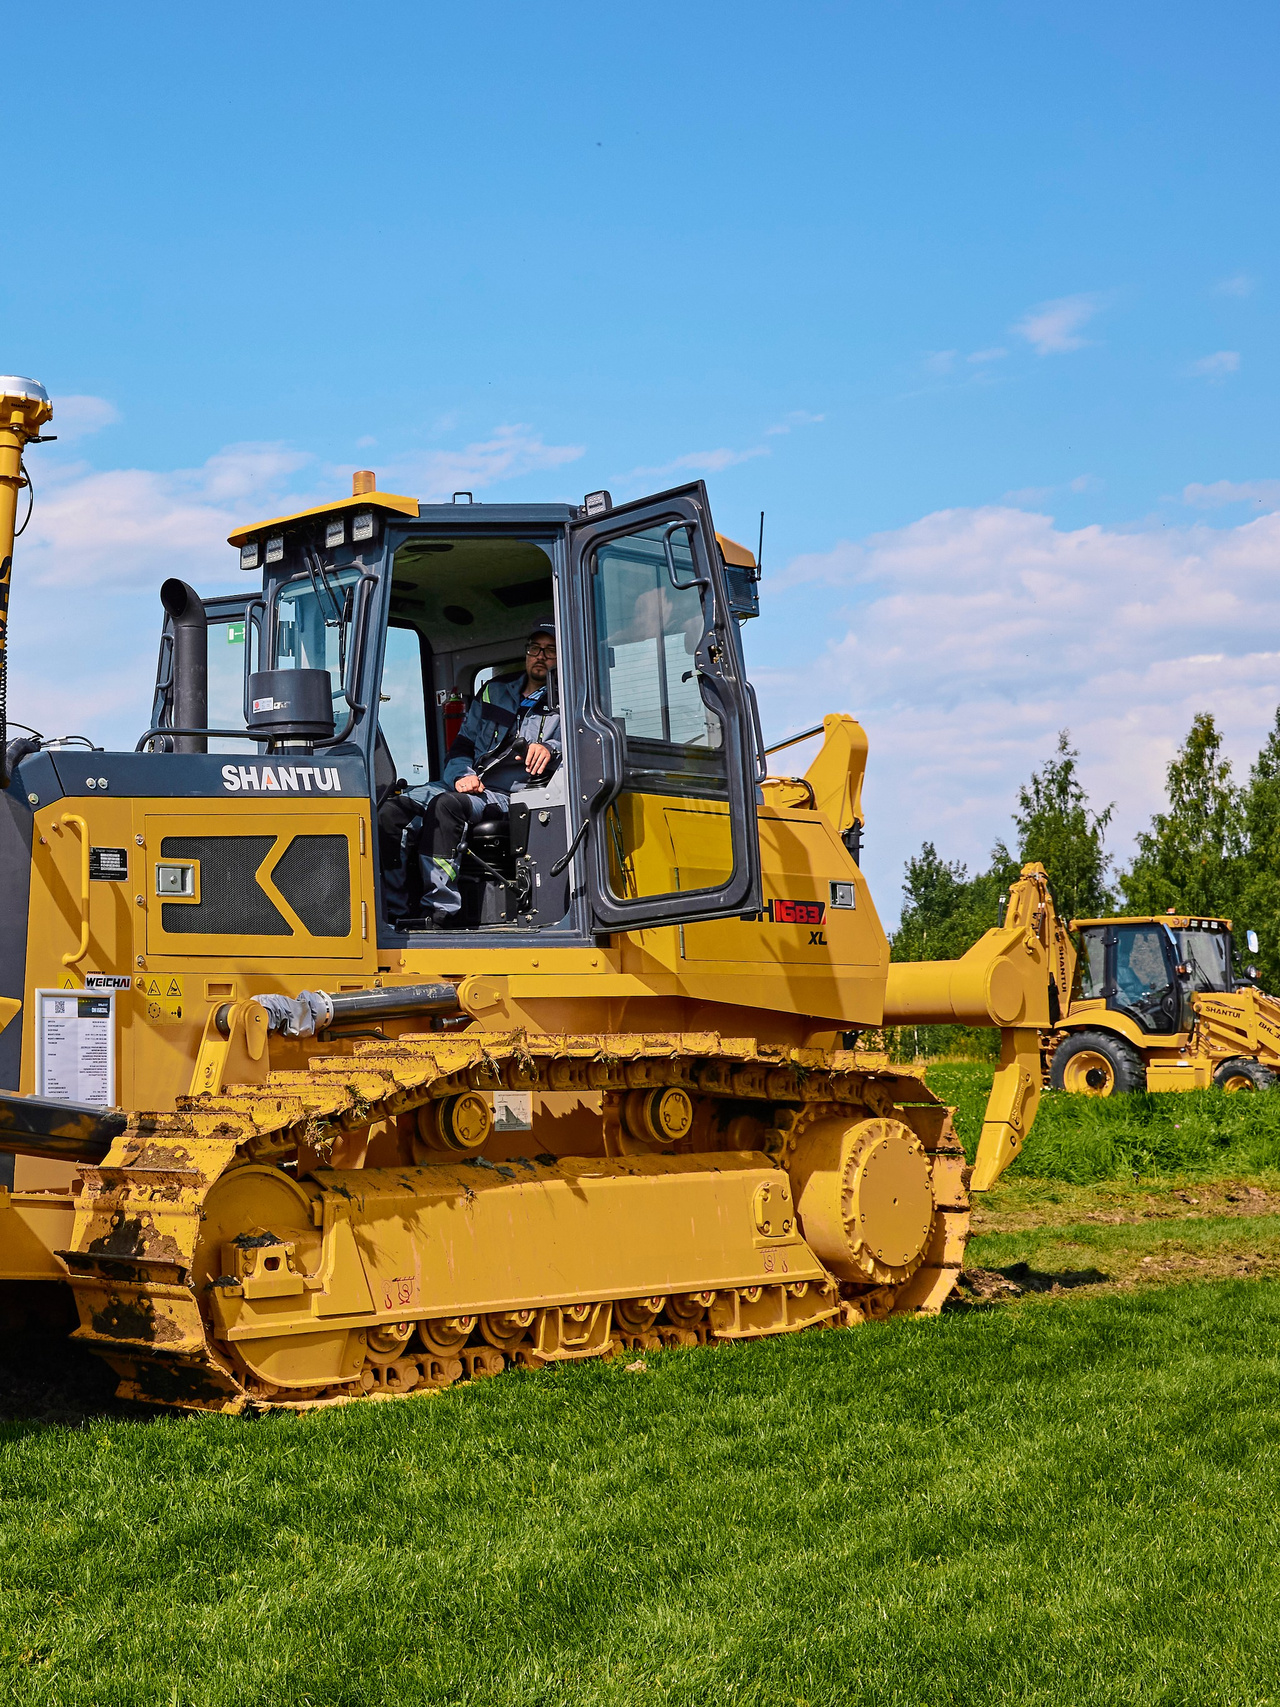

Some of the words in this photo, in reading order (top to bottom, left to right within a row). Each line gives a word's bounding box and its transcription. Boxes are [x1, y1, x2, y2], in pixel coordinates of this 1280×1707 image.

[221, 764, 341, 791] SHANTUI
[808, 931, 828, 946] XL
[1059, 945, 1067, 993] SHANTUI
[86, 977, 130, 988] WEICHAI
[1205, 1005, 1241, 1019] SHANTUI
[1258, 1021, 1274, 1036] BHL
